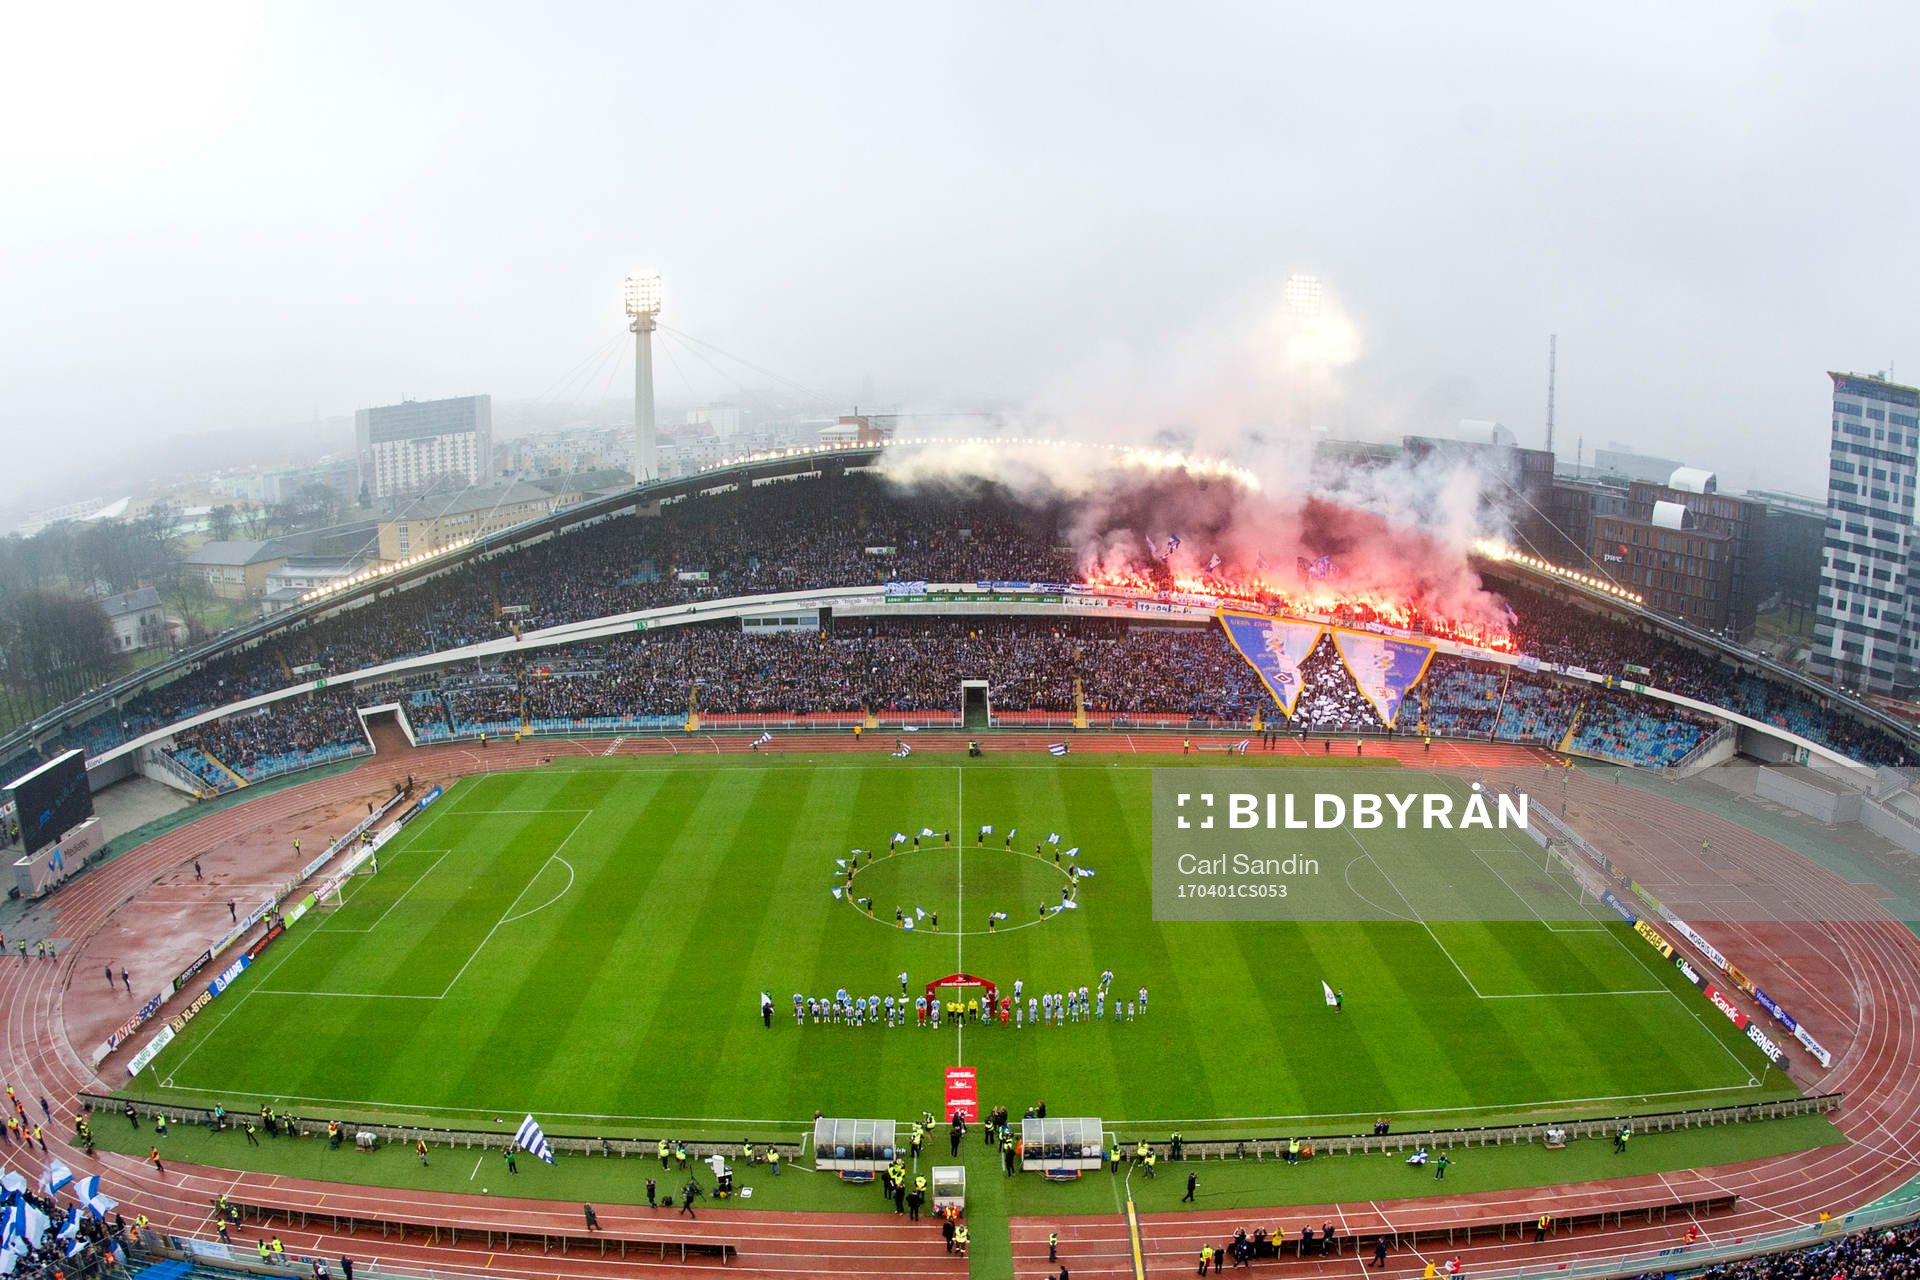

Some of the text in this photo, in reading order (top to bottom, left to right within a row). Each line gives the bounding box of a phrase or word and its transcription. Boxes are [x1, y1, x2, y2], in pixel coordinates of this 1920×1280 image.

[1604, 554, 1623, 563] pwc
[1639, 923, 1662, 948] EHRAB
[1689, 930, 1725, 966] MORRIS LAW
[222, 959, 243, 985] MAPEI
[116, 993, 162, 1042] INTERSPORT
[182, 990, 213, 1022] XL-BYGG
[1710, 991, 1740, 1023] Scandic
[1746, 1024, 1784, 1063] SERNEKE
